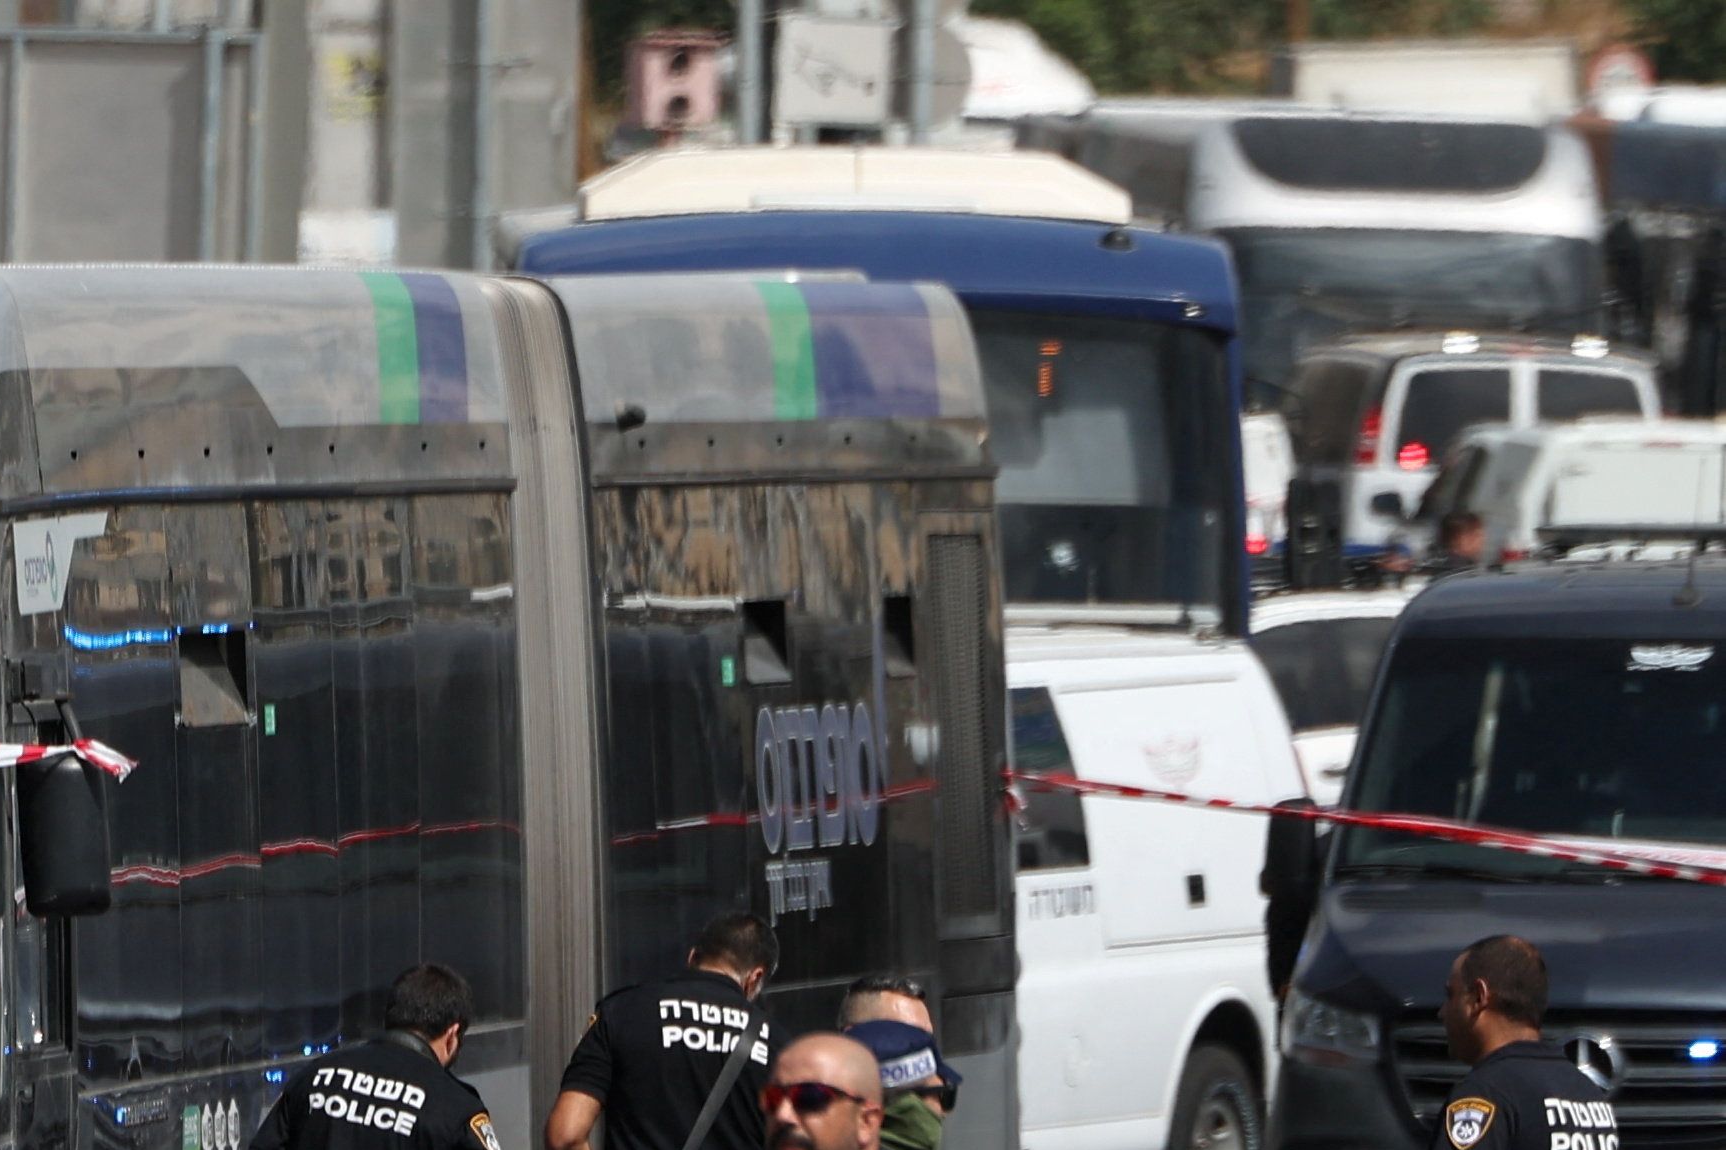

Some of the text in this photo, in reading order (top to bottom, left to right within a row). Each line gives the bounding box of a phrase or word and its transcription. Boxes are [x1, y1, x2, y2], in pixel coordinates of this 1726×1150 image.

[312, 1067, 427, 1110] משטרה
[308, 1092, 417, 1138] POLICE
[1544, 1098, 1618, 1130] שטרה
